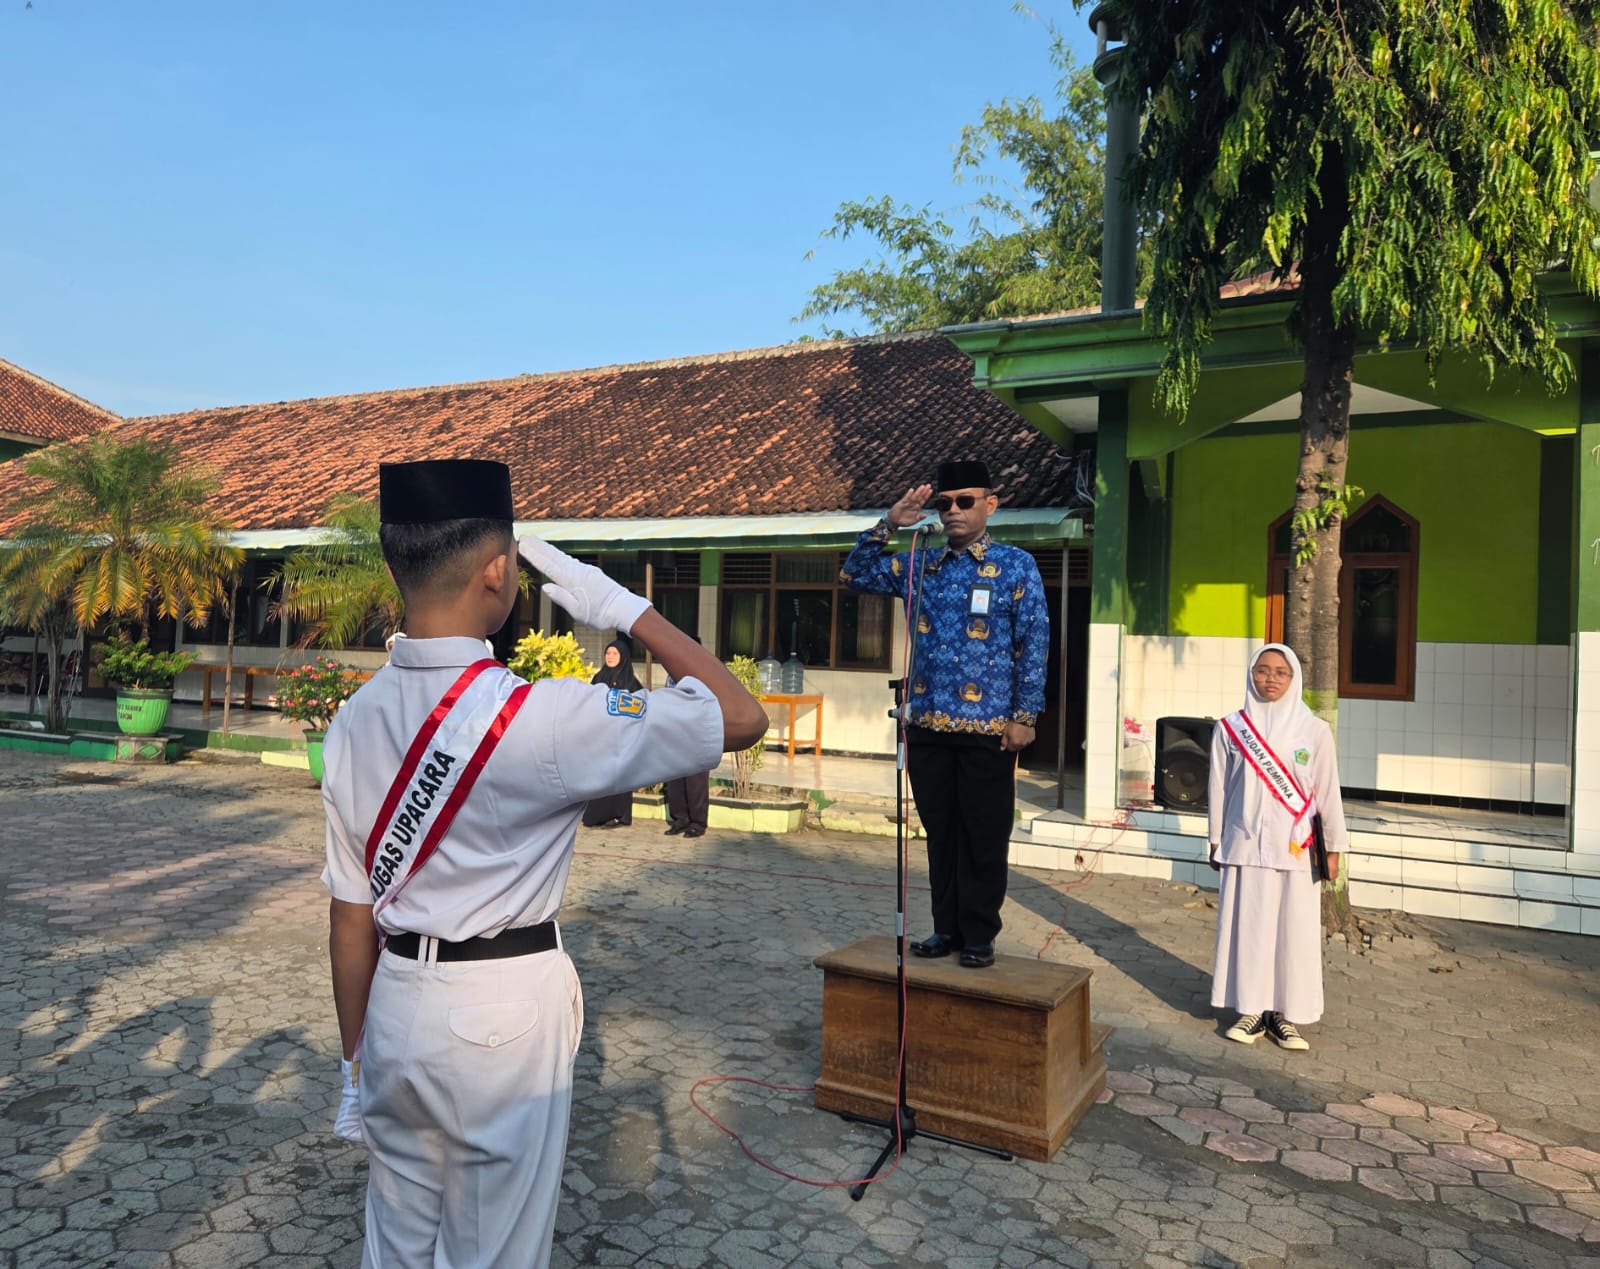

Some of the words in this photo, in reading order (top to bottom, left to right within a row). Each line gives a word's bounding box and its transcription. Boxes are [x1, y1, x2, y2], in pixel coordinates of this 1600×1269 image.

[1240, 729, 1266, 760] AJUDAN
[1263, 761, 1293, 799] PEMBINA
[370, 842, 404, 902] UGAS
[391, 750, 456, 846] UPACARA
